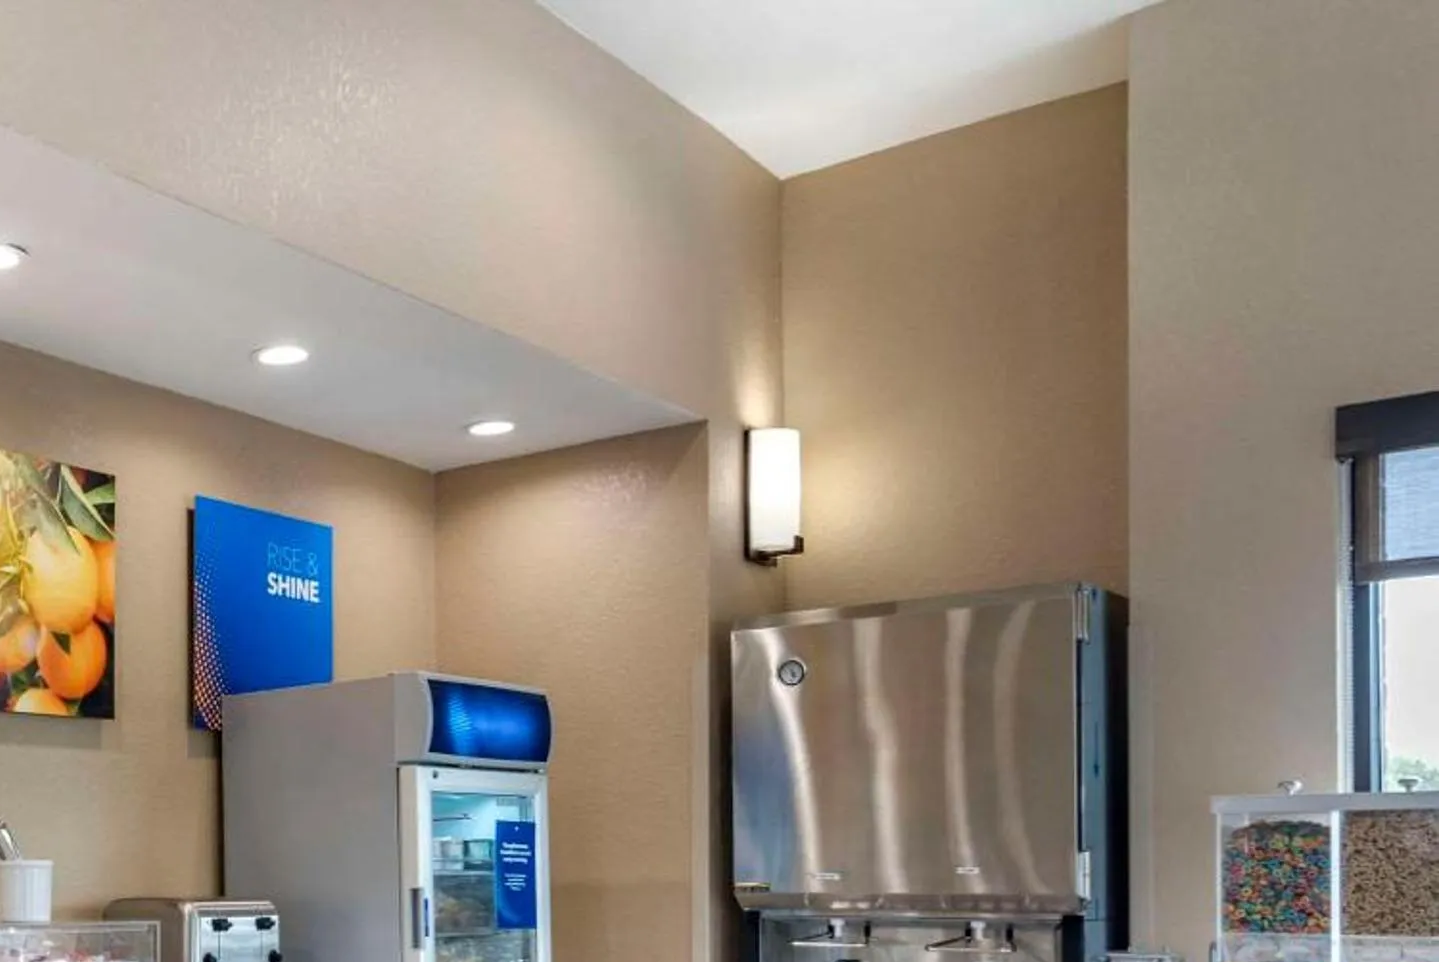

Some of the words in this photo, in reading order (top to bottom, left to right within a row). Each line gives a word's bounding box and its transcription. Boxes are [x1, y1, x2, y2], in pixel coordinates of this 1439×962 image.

[267, 542, 302, 573] RISE
[308, 552, 319, 577] &
[267, 571, 320, 603] SHINE
